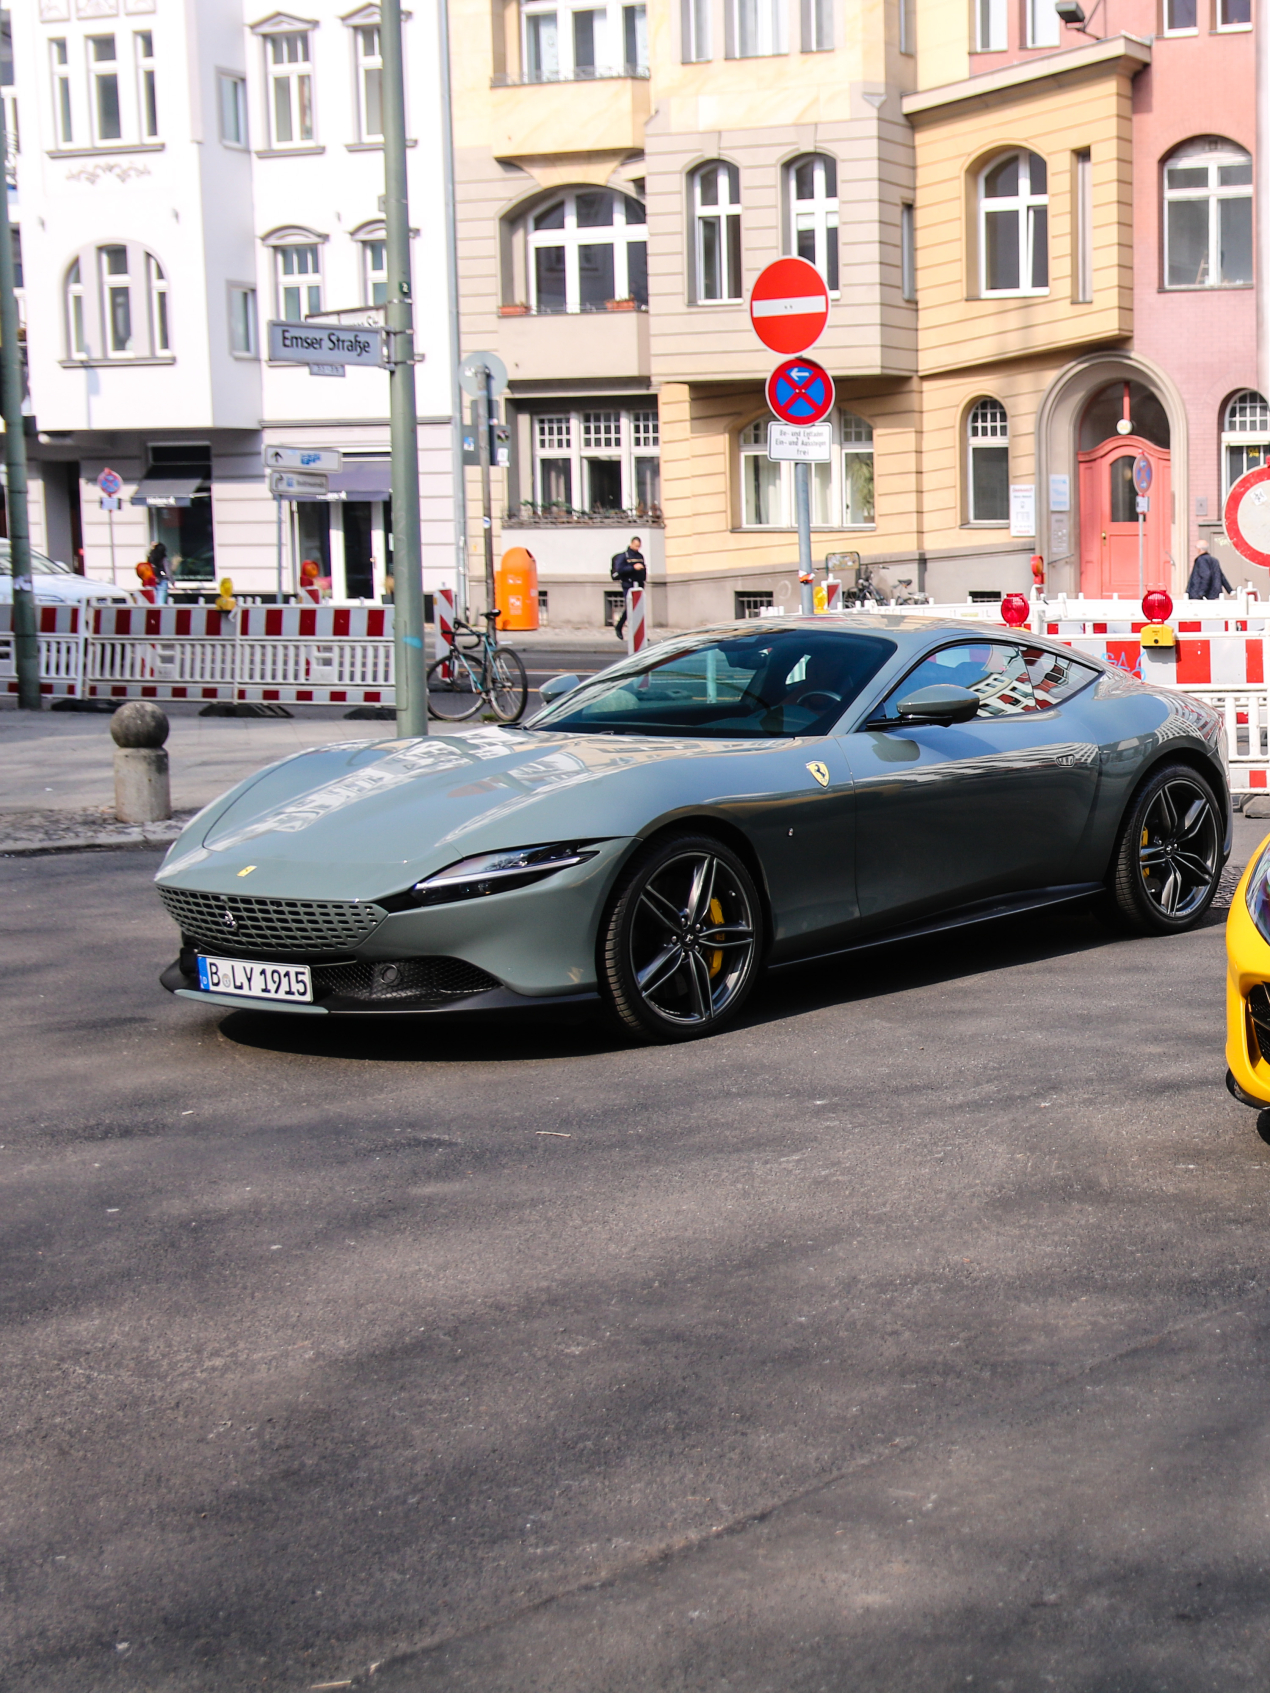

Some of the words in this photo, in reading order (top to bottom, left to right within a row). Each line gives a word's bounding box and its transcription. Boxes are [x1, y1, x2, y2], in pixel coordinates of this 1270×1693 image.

[281, 329, 323, 350] Emser
[327, 332, 371, 356] Straße
[209, 962, 221, 987] B
[231, 965, 253, 991] LY
[260, 968, 308, 996] 1915
